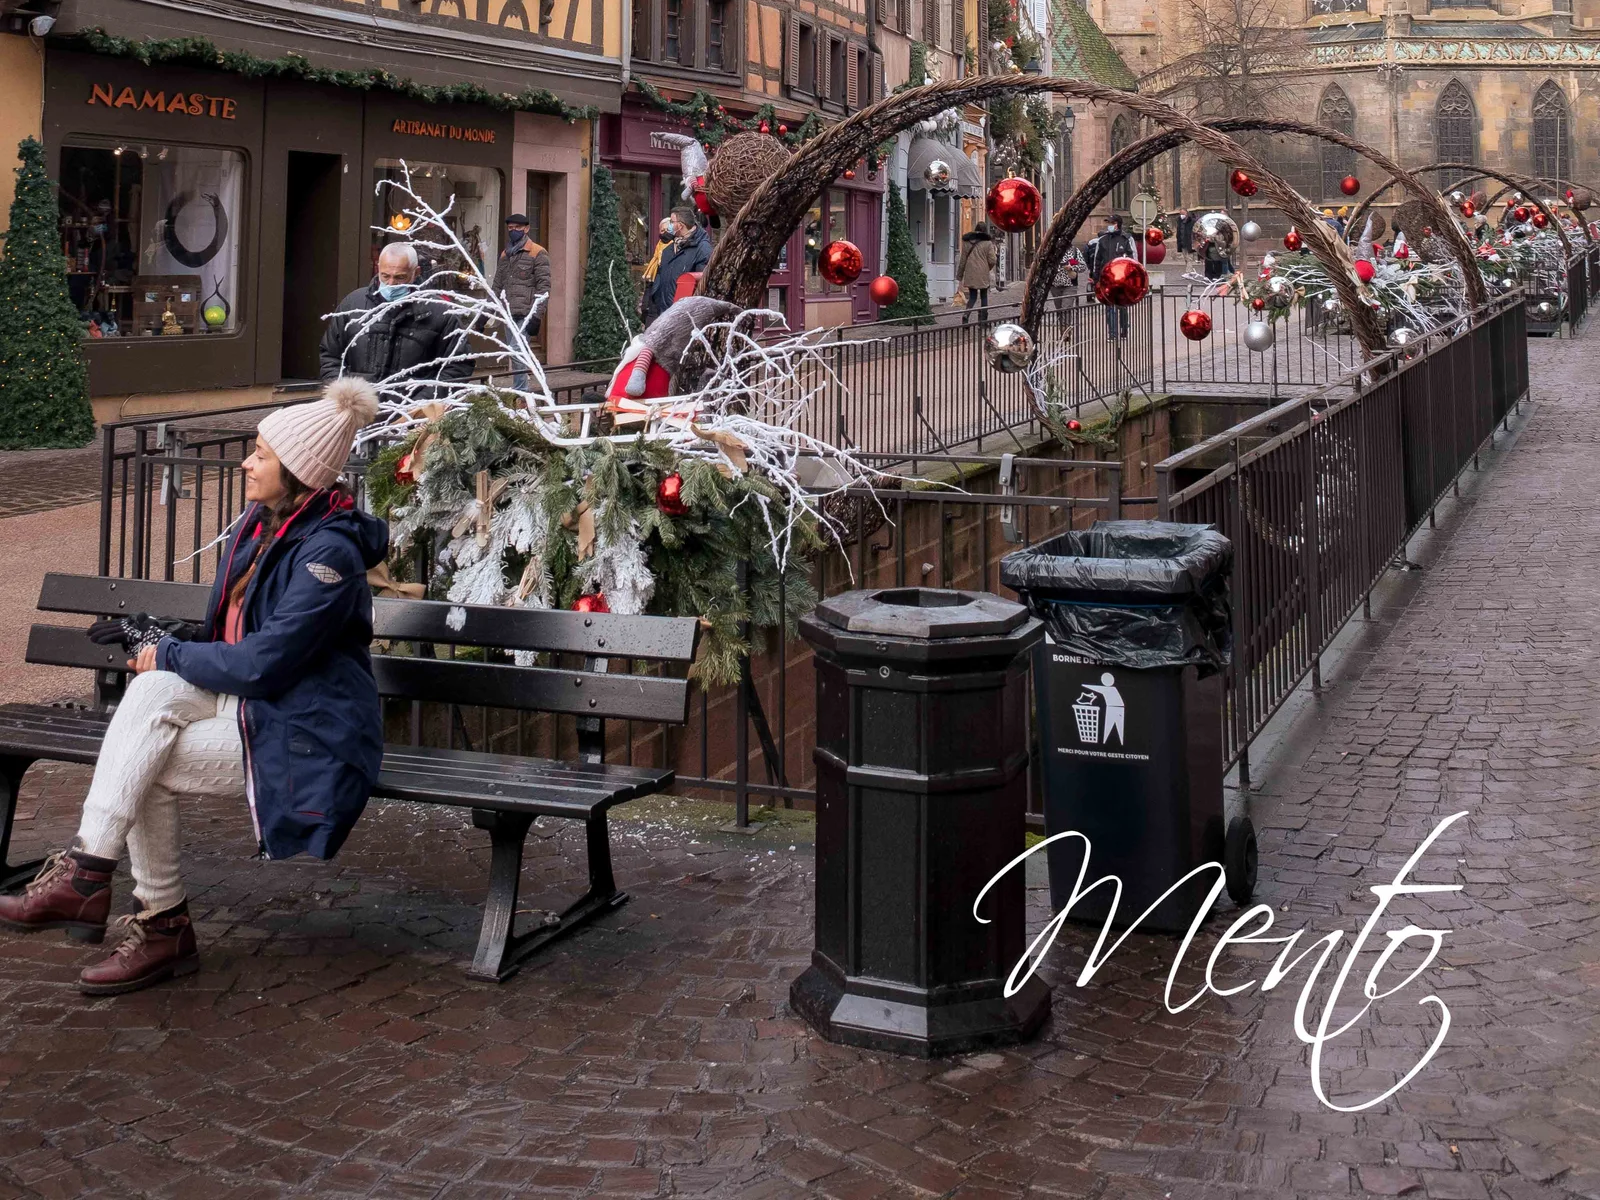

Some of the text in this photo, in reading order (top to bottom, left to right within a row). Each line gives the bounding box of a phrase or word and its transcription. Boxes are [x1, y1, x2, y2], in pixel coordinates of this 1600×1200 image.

[87, 82, 238, 120] NAMASTE
[393, 119, 496, 144] ARTISANAT DU MONDE
[1052, 654, 1082, 664] BORNE
[1083, 656, 1096, 665] DE
